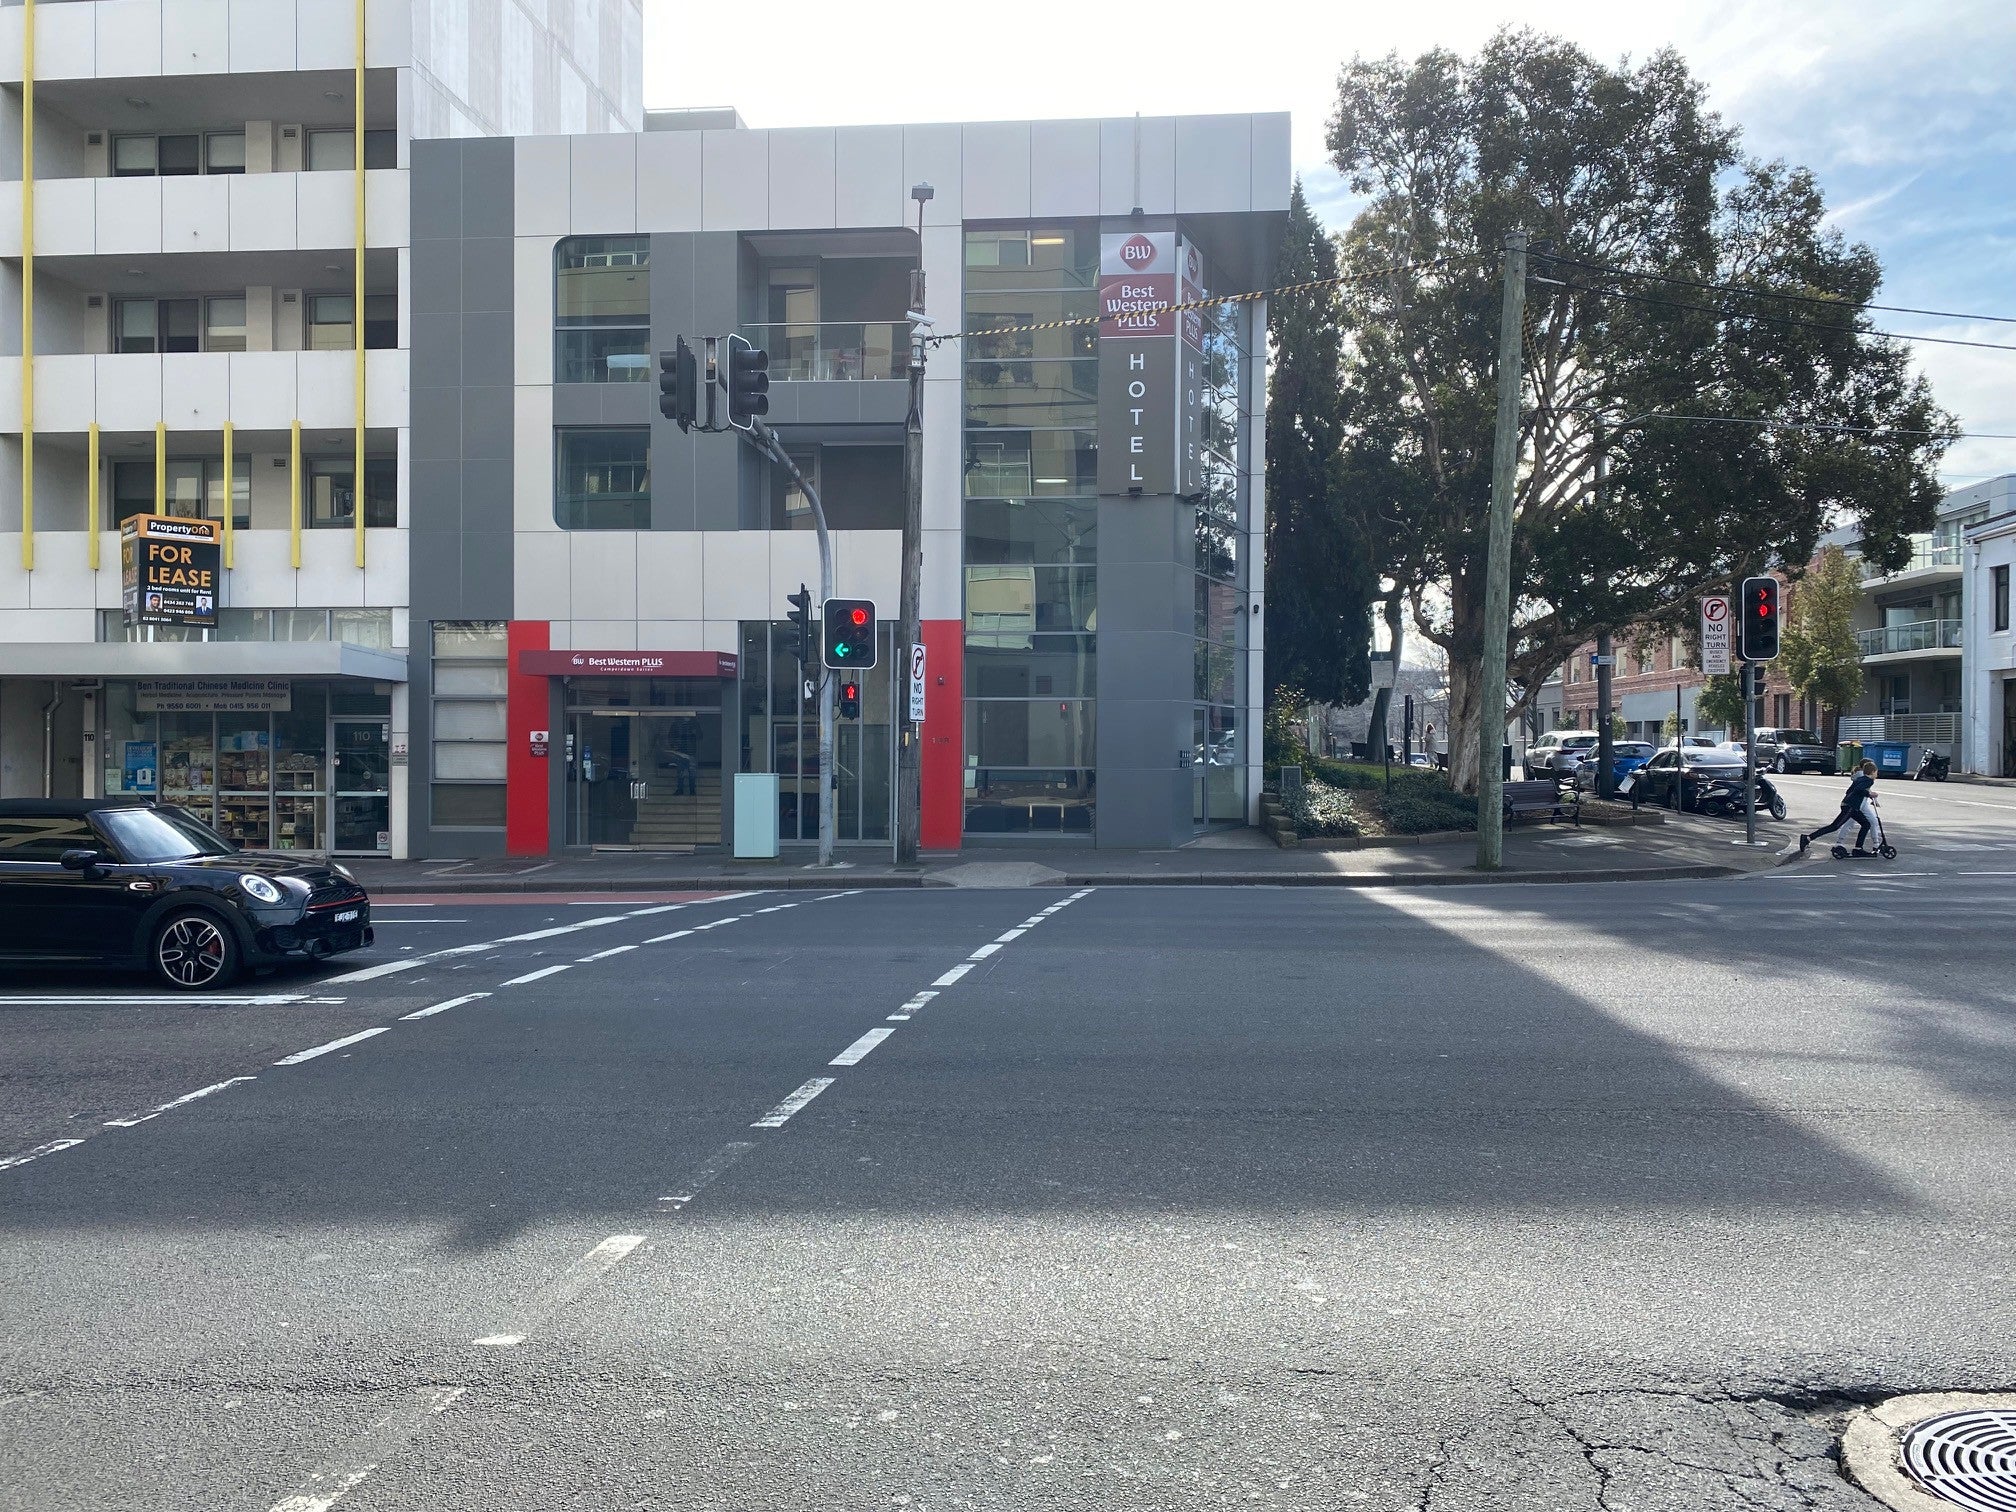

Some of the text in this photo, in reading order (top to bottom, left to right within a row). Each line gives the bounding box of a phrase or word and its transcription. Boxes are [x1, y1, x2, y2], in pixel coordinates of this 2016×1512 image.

[1125, 245, 1151, 260] BW
[1121, 285, 1155, 298] Best
[1106, 299, 1168, 313] Western
[1117, 312, 1157, 327] PLUS
[1128, 353, 1146, 481] HOTEL
[150, 521, 210, 536] PropertyOne
[149, 544, 192, 565] FOR
[148, 566, 212, 588] LEASE
[1708, 624, 1723, 632] NO
[588, 658, 607, 666] Best
[607, 658, 640, 666] Western
[641, 658, 663, 666] PLUS
[137, 681, 289, 690] Ben Traditional Chinese Medicine Clinic
[913, 683, 923, 694] NO
[912, 697, 924, 705] RIGHT
[912, 708, 924, 716] TURN
[83, 733, 95, 742] 110
[352, 731, 371, 741] 110
